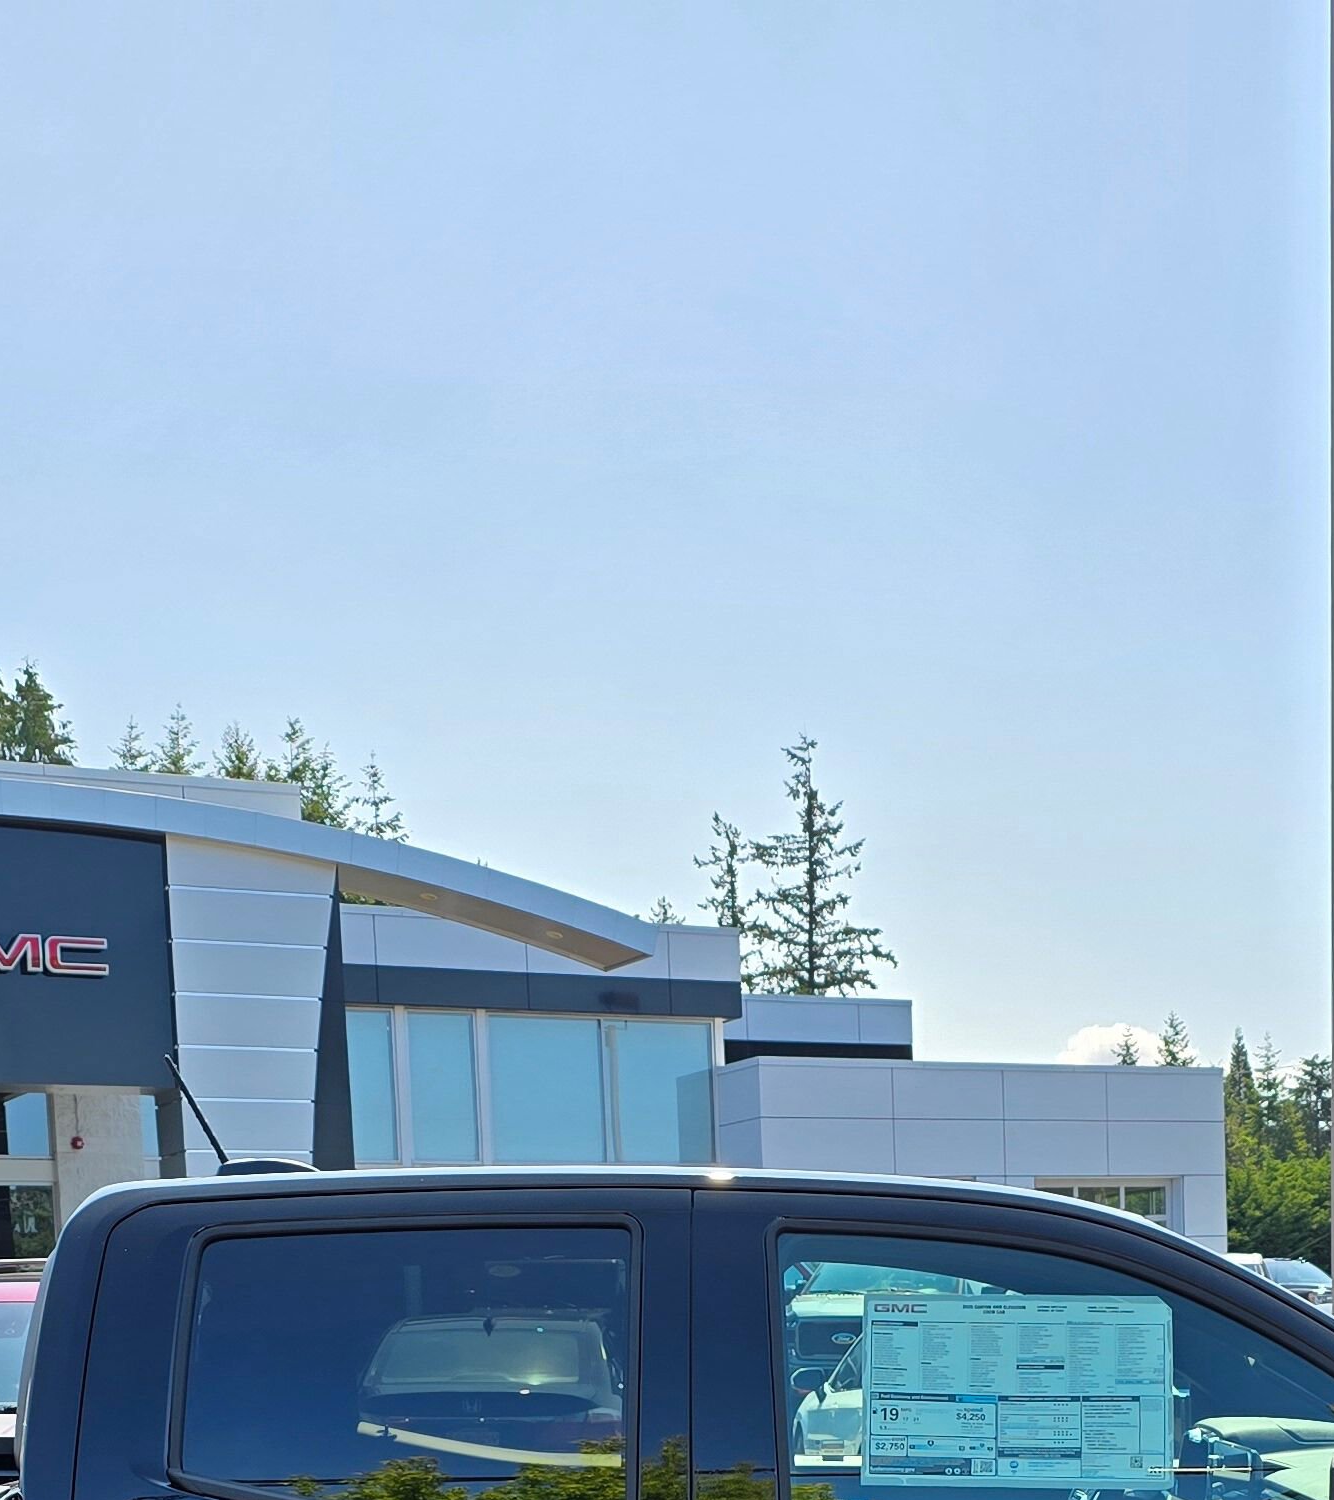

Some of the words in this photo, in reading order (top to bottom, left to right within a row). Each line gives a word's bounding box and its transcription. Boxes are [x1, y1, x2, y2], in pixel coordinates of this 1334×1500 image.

[874, 1303, 928, 1314] GMC
[880, 1407, 899, 1422] 19
[956, 1412, 986, 1422] $4,250
[875, 1442, 905, 1451] $2,750
